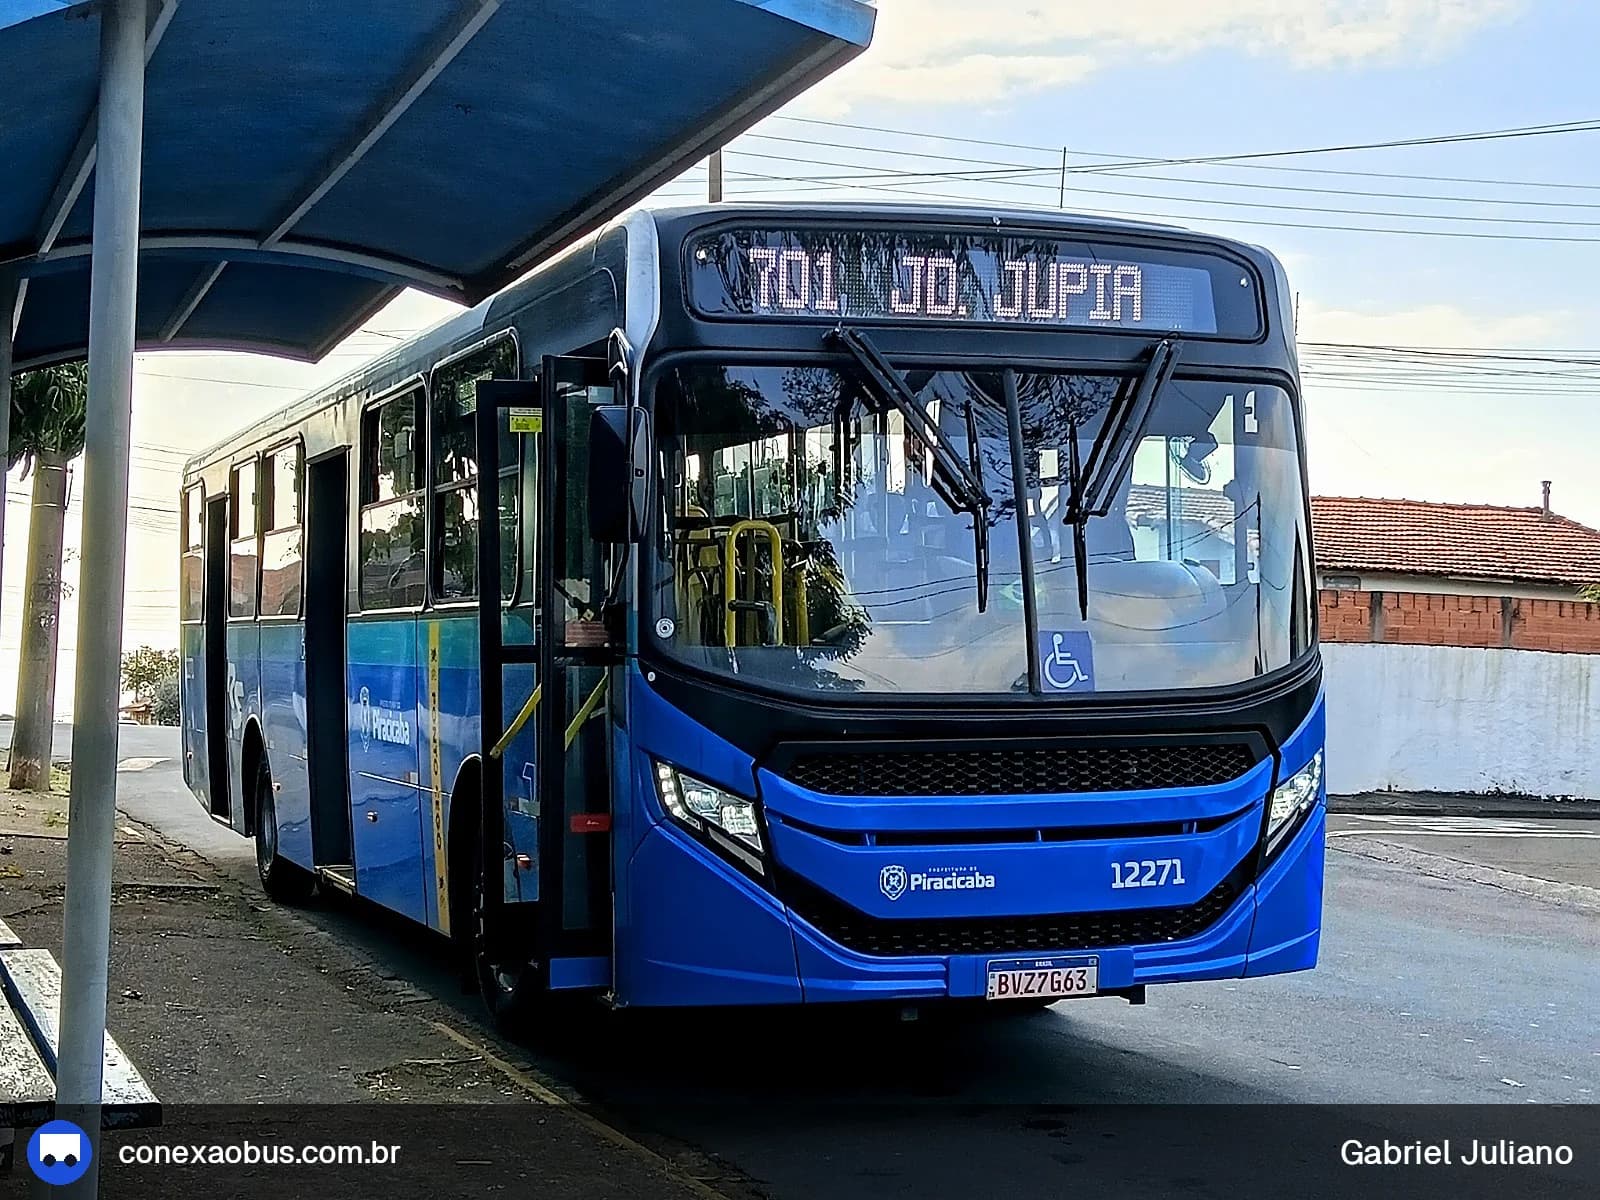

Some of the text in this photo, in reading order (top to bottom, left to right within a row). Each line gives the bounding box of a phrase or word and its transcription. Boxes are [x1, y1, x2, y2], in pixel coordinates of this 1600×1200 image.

[748, 246, 1141, 321] 701 JD. JUPIA
[372, 709, 410, 746] Piracicaba
[910, 872, 995, 891] Piracicaba
[1110, 858, 1186, 889] 12271
[998, 969, 1087, 996] BVZ7G63
